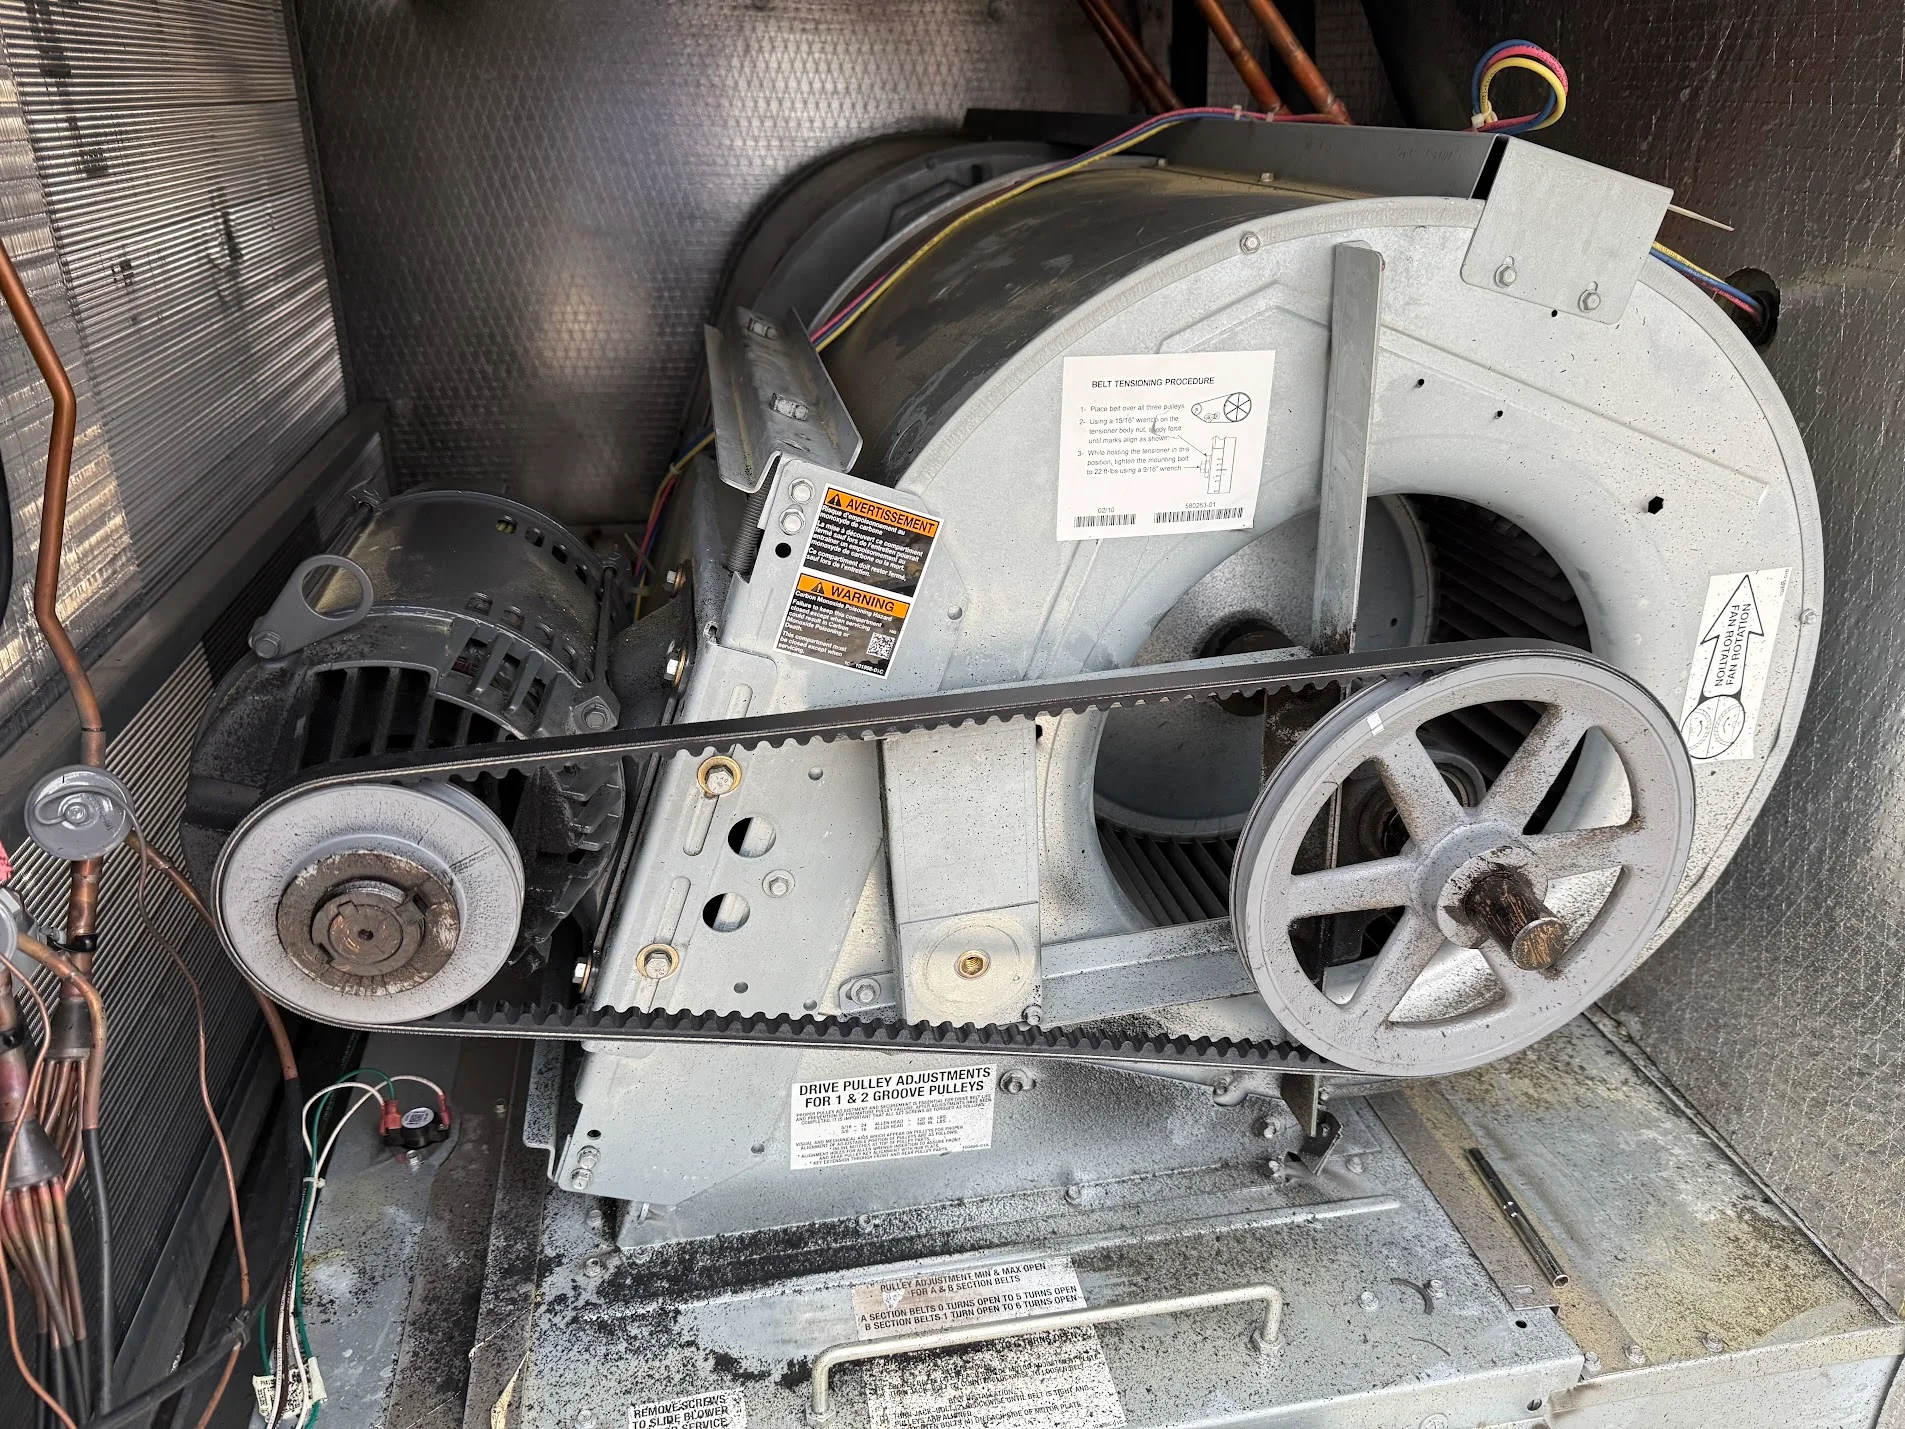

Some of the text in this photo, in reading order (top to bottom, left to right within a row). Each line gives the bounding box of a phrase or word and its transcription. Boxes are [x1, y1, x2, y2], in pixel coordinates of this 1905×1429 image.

[1092, 377, 1214, 388] BELT TENSIONING PROCEDURE
[819, 512, 850, 525] monoxyde
[859, 524, 883, 535] carbone
[821, 504, 842, 516] Risque
[843, 512, 897, 533] d'empoisonnement
[846, 498, 934, 533] AVERTISSEMENT
[795, 590, 892, 621] Carbon Monoxide Poisoning Hazard
[832, 585, 894, 612] WARNING
[785, 622, 802, 631] Death.
[787, 616, 814, 628] Monoxide
[815, 624, 842, 636] Poisoning
[790, 605, 870, 631] closed except when servicing
[792, 599, 812, 608] Failure
[819, 606, 833, 615] keep
[845, 614, 882, 628] compartment
[805, 616, 821, 624] result
[828, 622, 849, 631] Carbon
[778, 643, 804, 654] servicing.
[783, 630, 794, 638] This
[795, 635, 832, 648] compartment
[788, 639, 808, 648] closed
[808, 644, 827, 653] except
[1714, 604, 1740, 687] FAN ROTATION
[1726, 603, 1752, 685] FAN ROTATION
[800, 1067, 990, 1095] DRIVE PULLEY ADJUSTMENTS
[806, 1080, 984, 1108] FOR 1 & 2 GROOVE PULLEYS
[880, 1280, 912, 1292] PULLEY
[915, 1273, 971, 1287] ADJUSTMENT
[974, 1270, 991, 1278] MIN
[1002, 1266, 1022, 1275] MAX
[1023, 1262, 1046, 1272] OPEN
[910, 1288, 928, 1297] FOR
[930, 1286, 937, 1294] A
[956, 1279, 992, 1290] SECTION
[994, 1275, 1020, 1285] BELTS
[861, 1314, 867, 1322] A
[869, 1309, 907, 1321] SECTION
[909, 1305, 936, 1315] BELTS
[946, 1299, 975, 1310] TURNS
[977, 1295, 1000, 1306] OPEN
[1002, 1294, 1014, 1302] TO
[1024, 1289, 1052, 1299] TURNS
[1054, 1285, 1077, 1295] OPEN
[874, 1317, 911, 1330] SECTION
[914, 1314, 941, 1324] BELTS
[950, 1309, 974, 1318] TURN
[976, 1305, 1000, 1314] OPEN
[1002, 1303, 1014, 1311] TO
[1024, 1298, 1053, 1308] TURNS
[1054, 1294, 1077, 1304] OPEN
[683, 1405, 729, 1421] BLOWER
